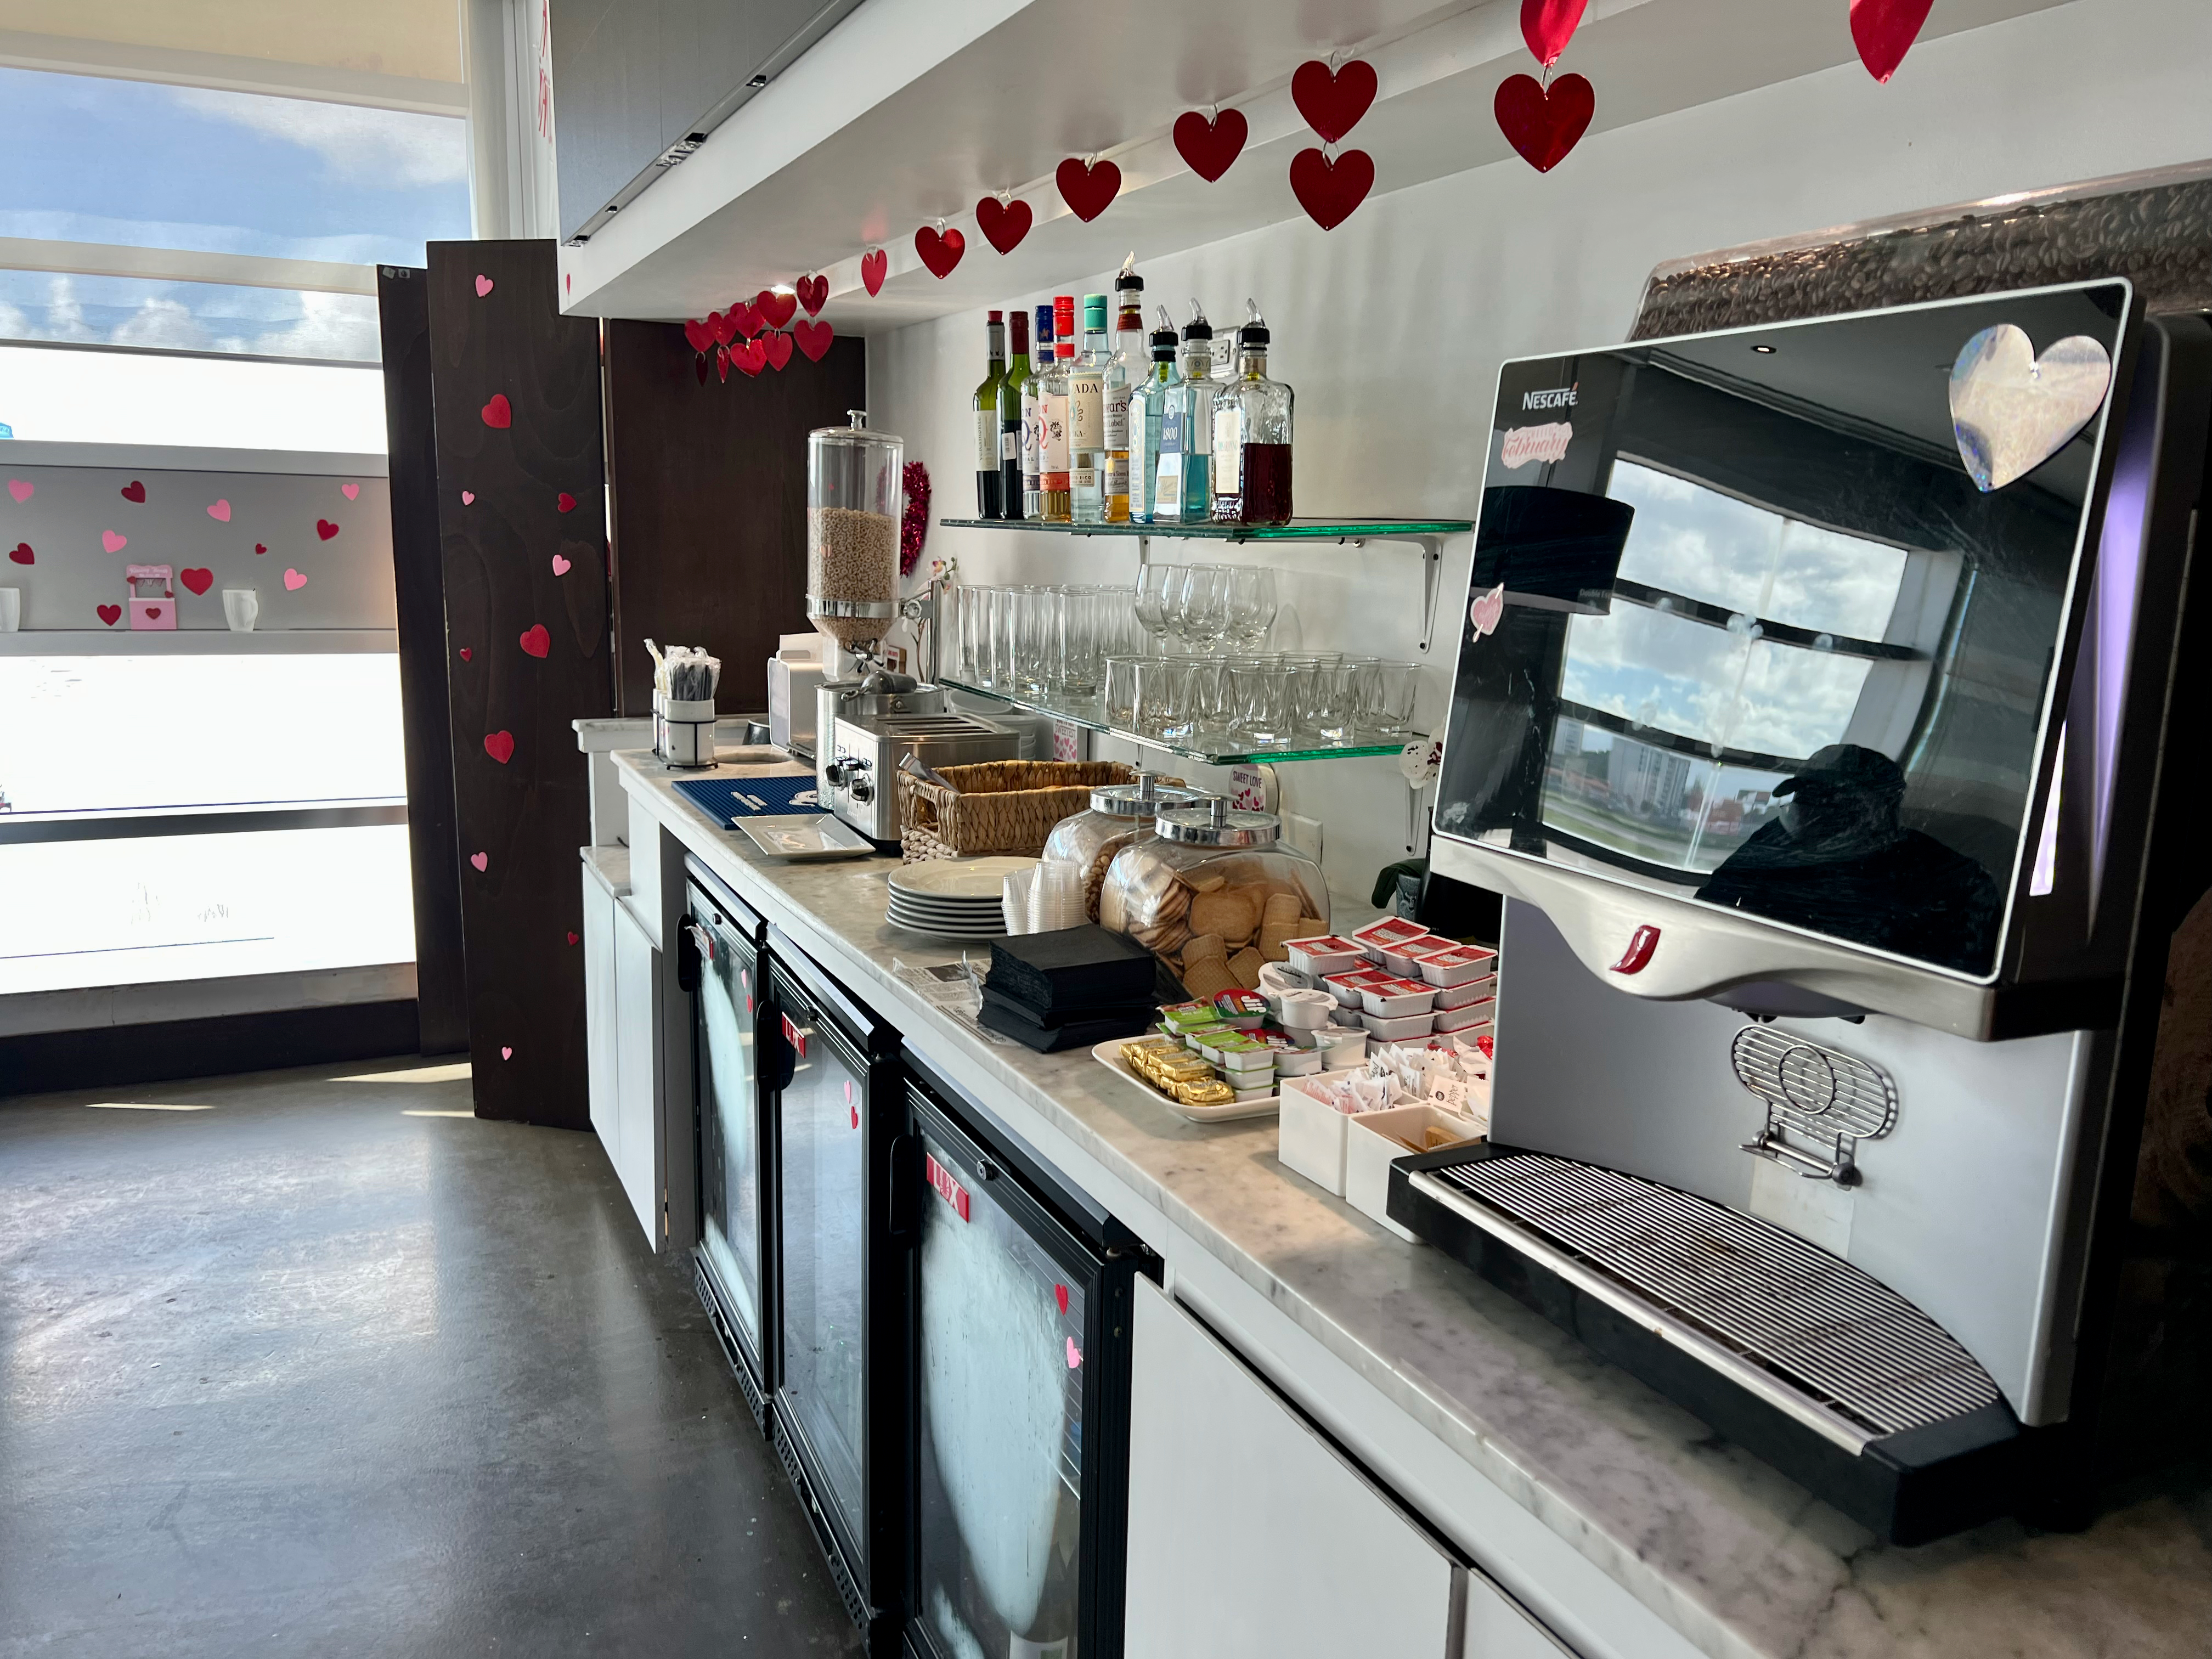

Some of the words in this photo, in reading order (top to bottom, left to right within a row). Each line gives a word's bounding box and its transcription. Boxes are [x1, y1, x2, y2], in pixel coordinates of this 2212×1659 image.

[1163, 426, 1178, 441] 1800
[1233, 770, 1249, 785] SWEET
[1250, 775, 1262, 788] LOVE
[785, 1019, 800, 1054] LUX
[1446, 1084, 1460, 1106] pepper
[933, 1161, 960, 1215] LUX
